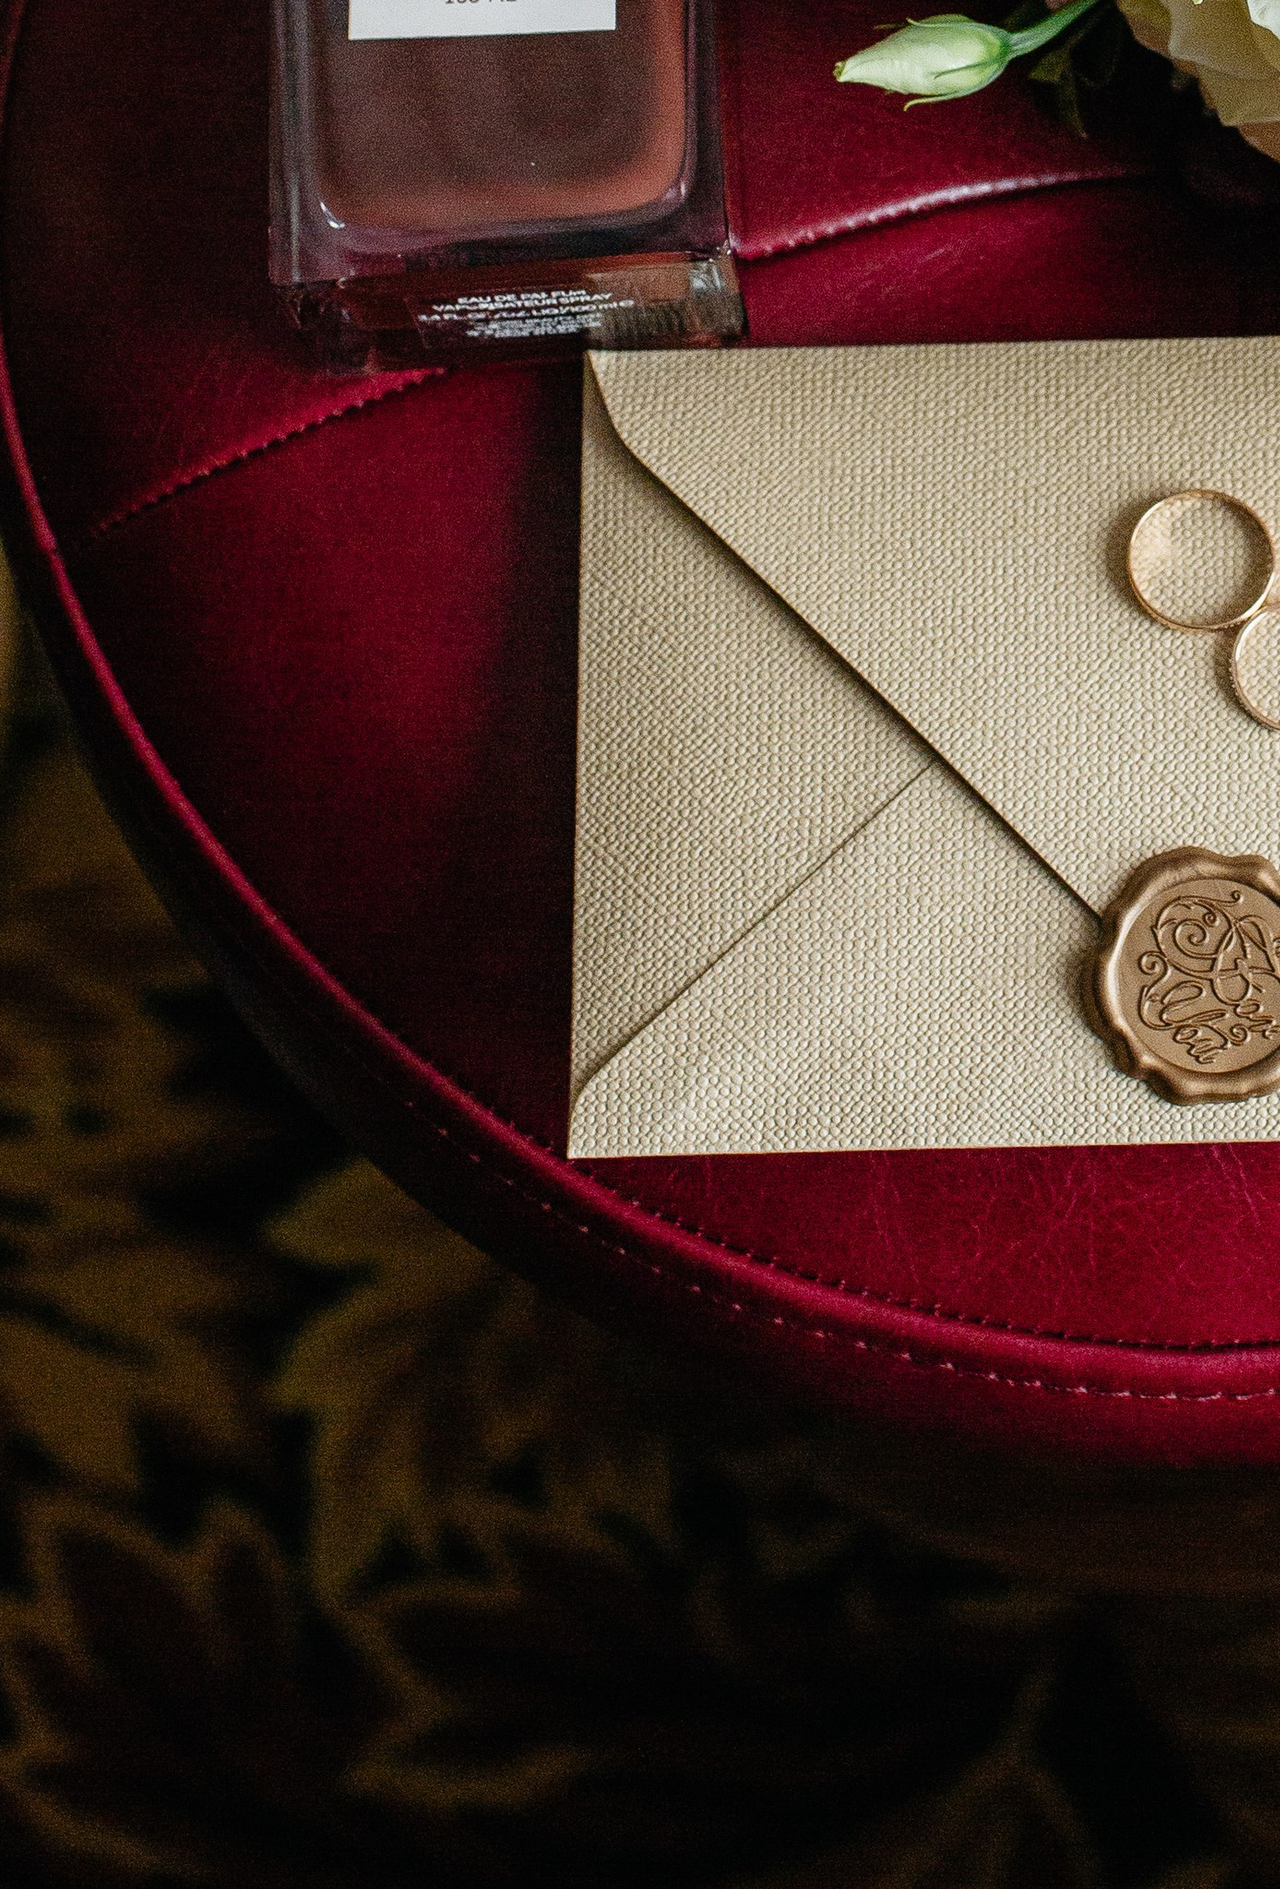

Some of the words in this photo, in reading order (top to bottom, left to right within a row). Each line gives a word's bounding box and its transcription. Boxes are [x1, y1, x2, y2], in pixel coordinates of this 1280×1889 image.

[457, 295, 491, 304] EAU
[494, 293, 517, 302] DE
[559, 293, 612, 305] SPRAY
